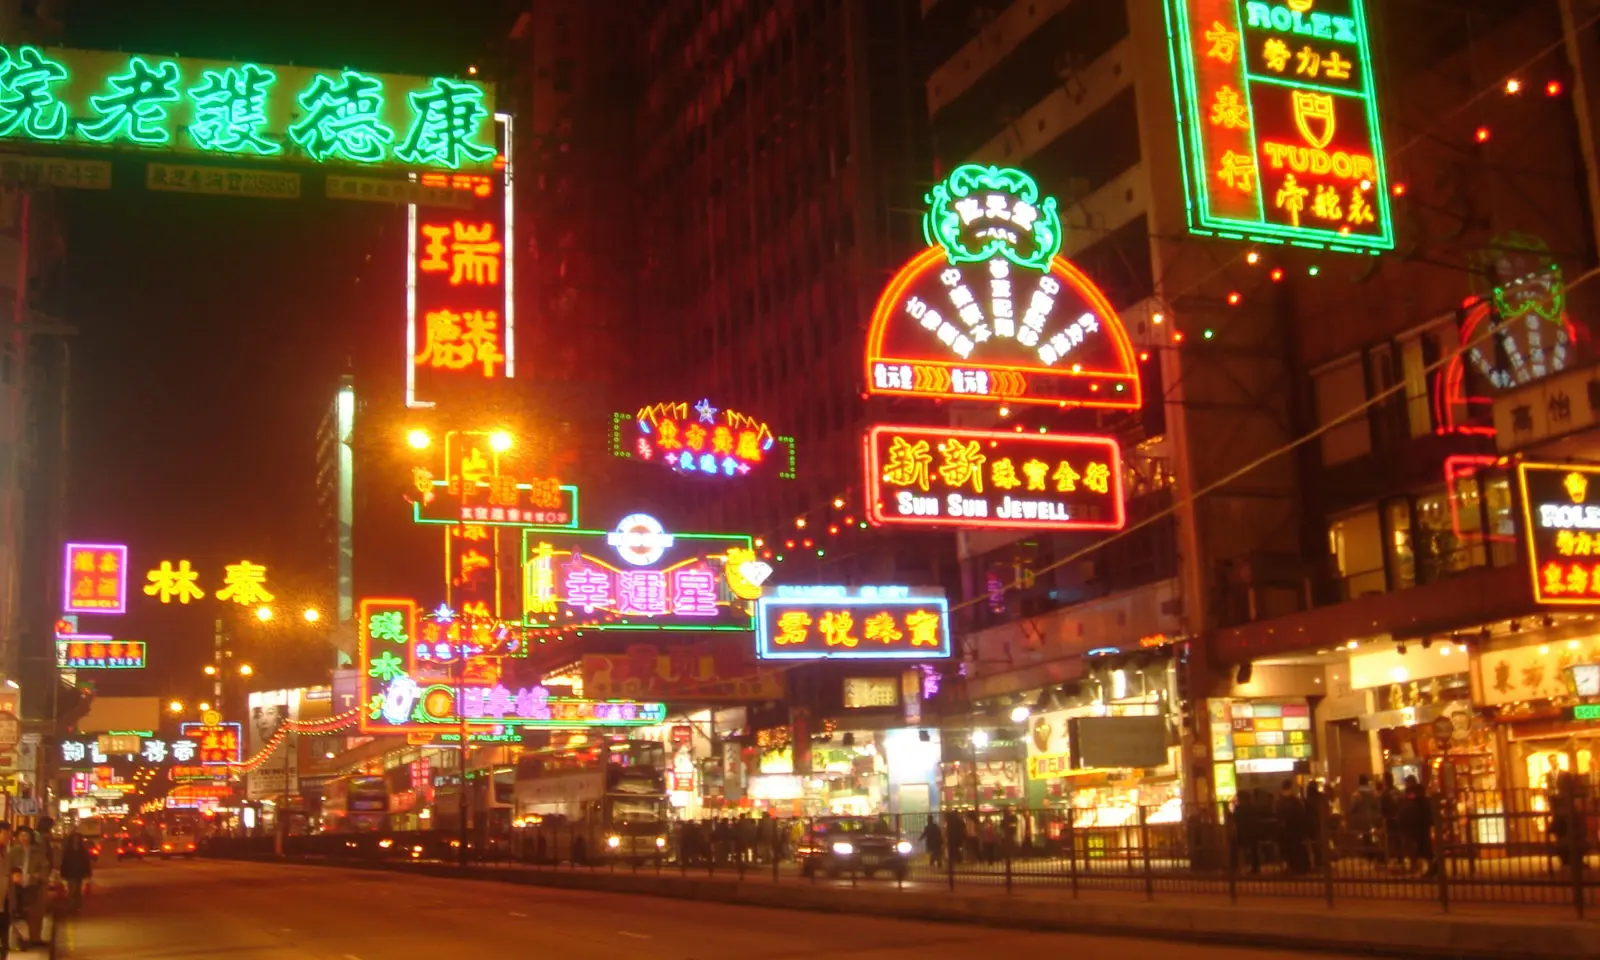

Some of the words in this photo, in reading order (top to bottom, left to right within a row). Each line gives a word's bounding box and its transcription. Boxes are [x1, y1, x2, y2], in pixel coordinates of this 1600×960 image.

[1246, 2, 1358, 43] ROLEX
[1263, 38, 1352, 79] 勞力士
[1263, 142, 1376, 181] TUDOR
[566, 569, 719, 616] 幸運星
[774, 609, 939, 648] 君悅珠寶
